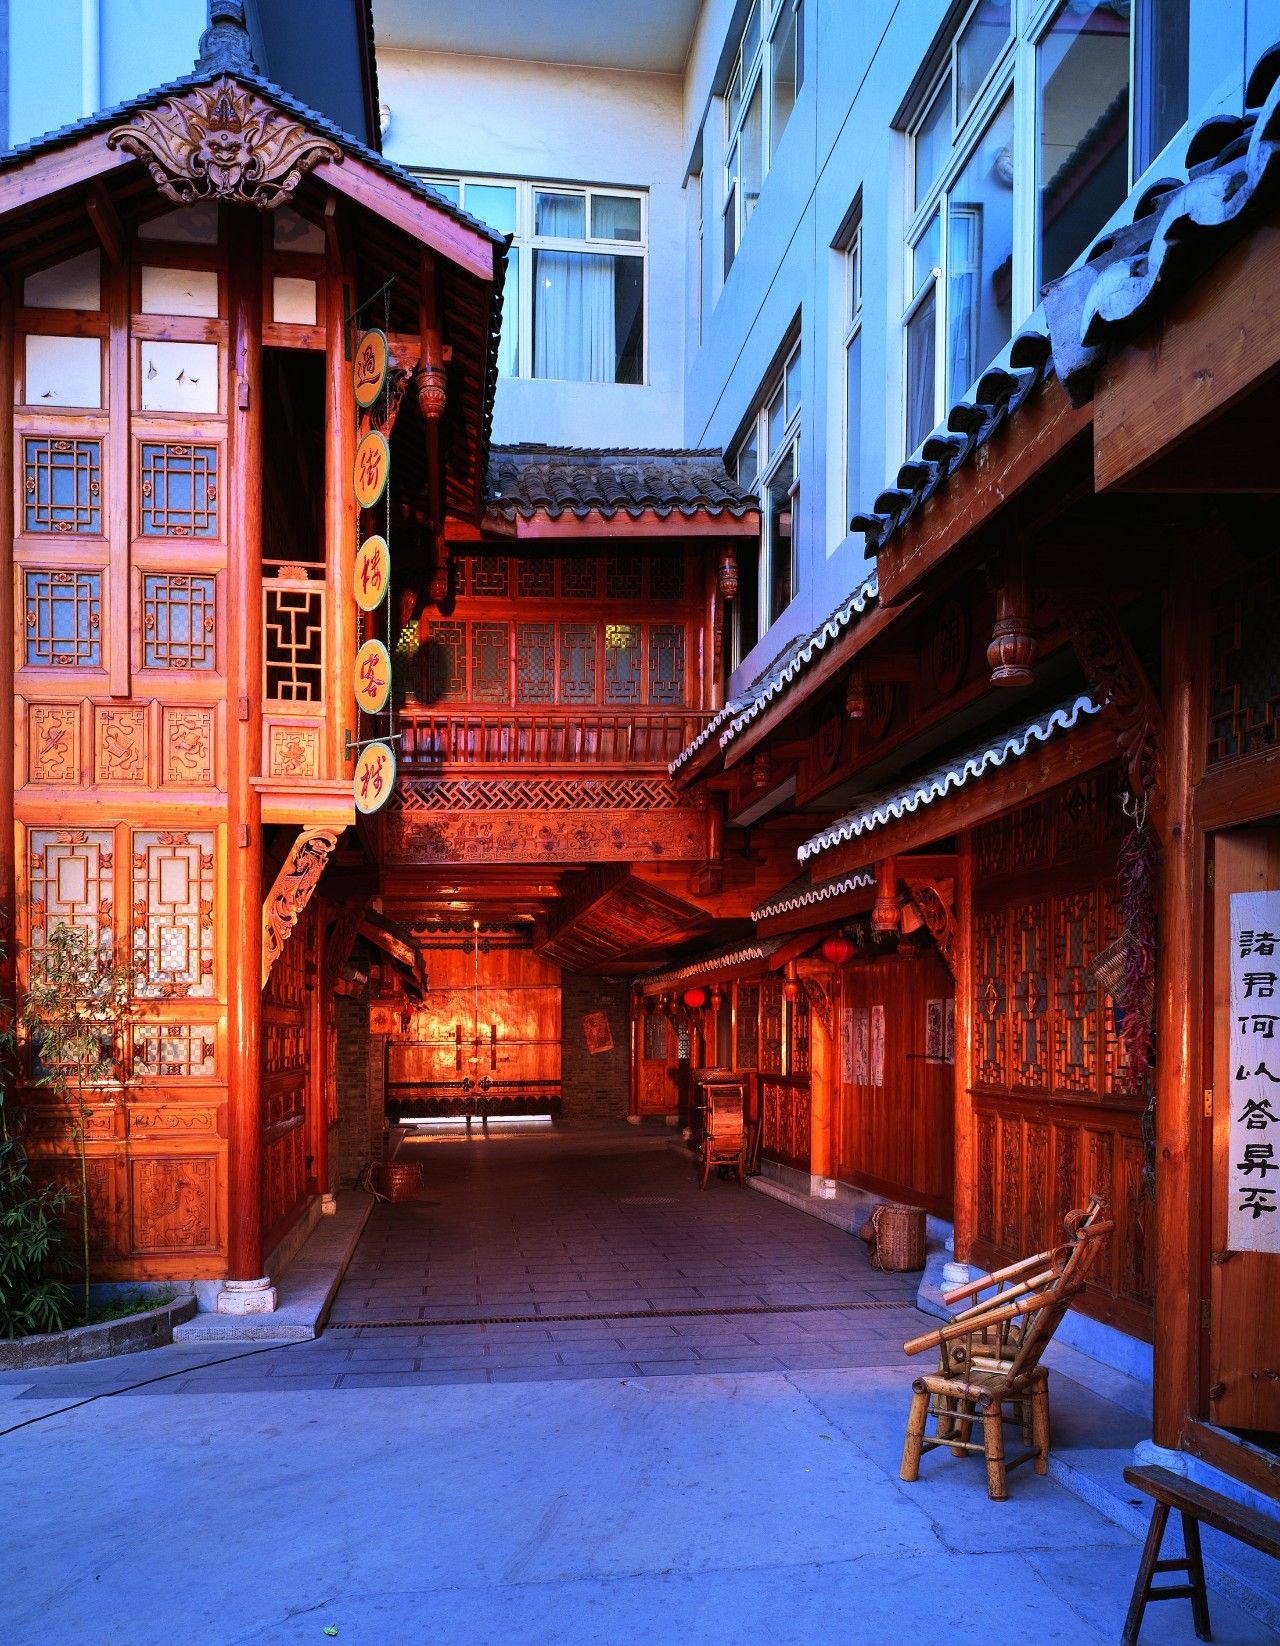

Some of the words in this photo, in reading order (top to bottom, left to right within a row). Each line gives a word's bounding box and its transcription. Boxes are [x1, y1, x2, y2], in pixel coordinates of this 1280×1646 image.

[1236, 930, 1280, 1219] 諸君何以答昇平
